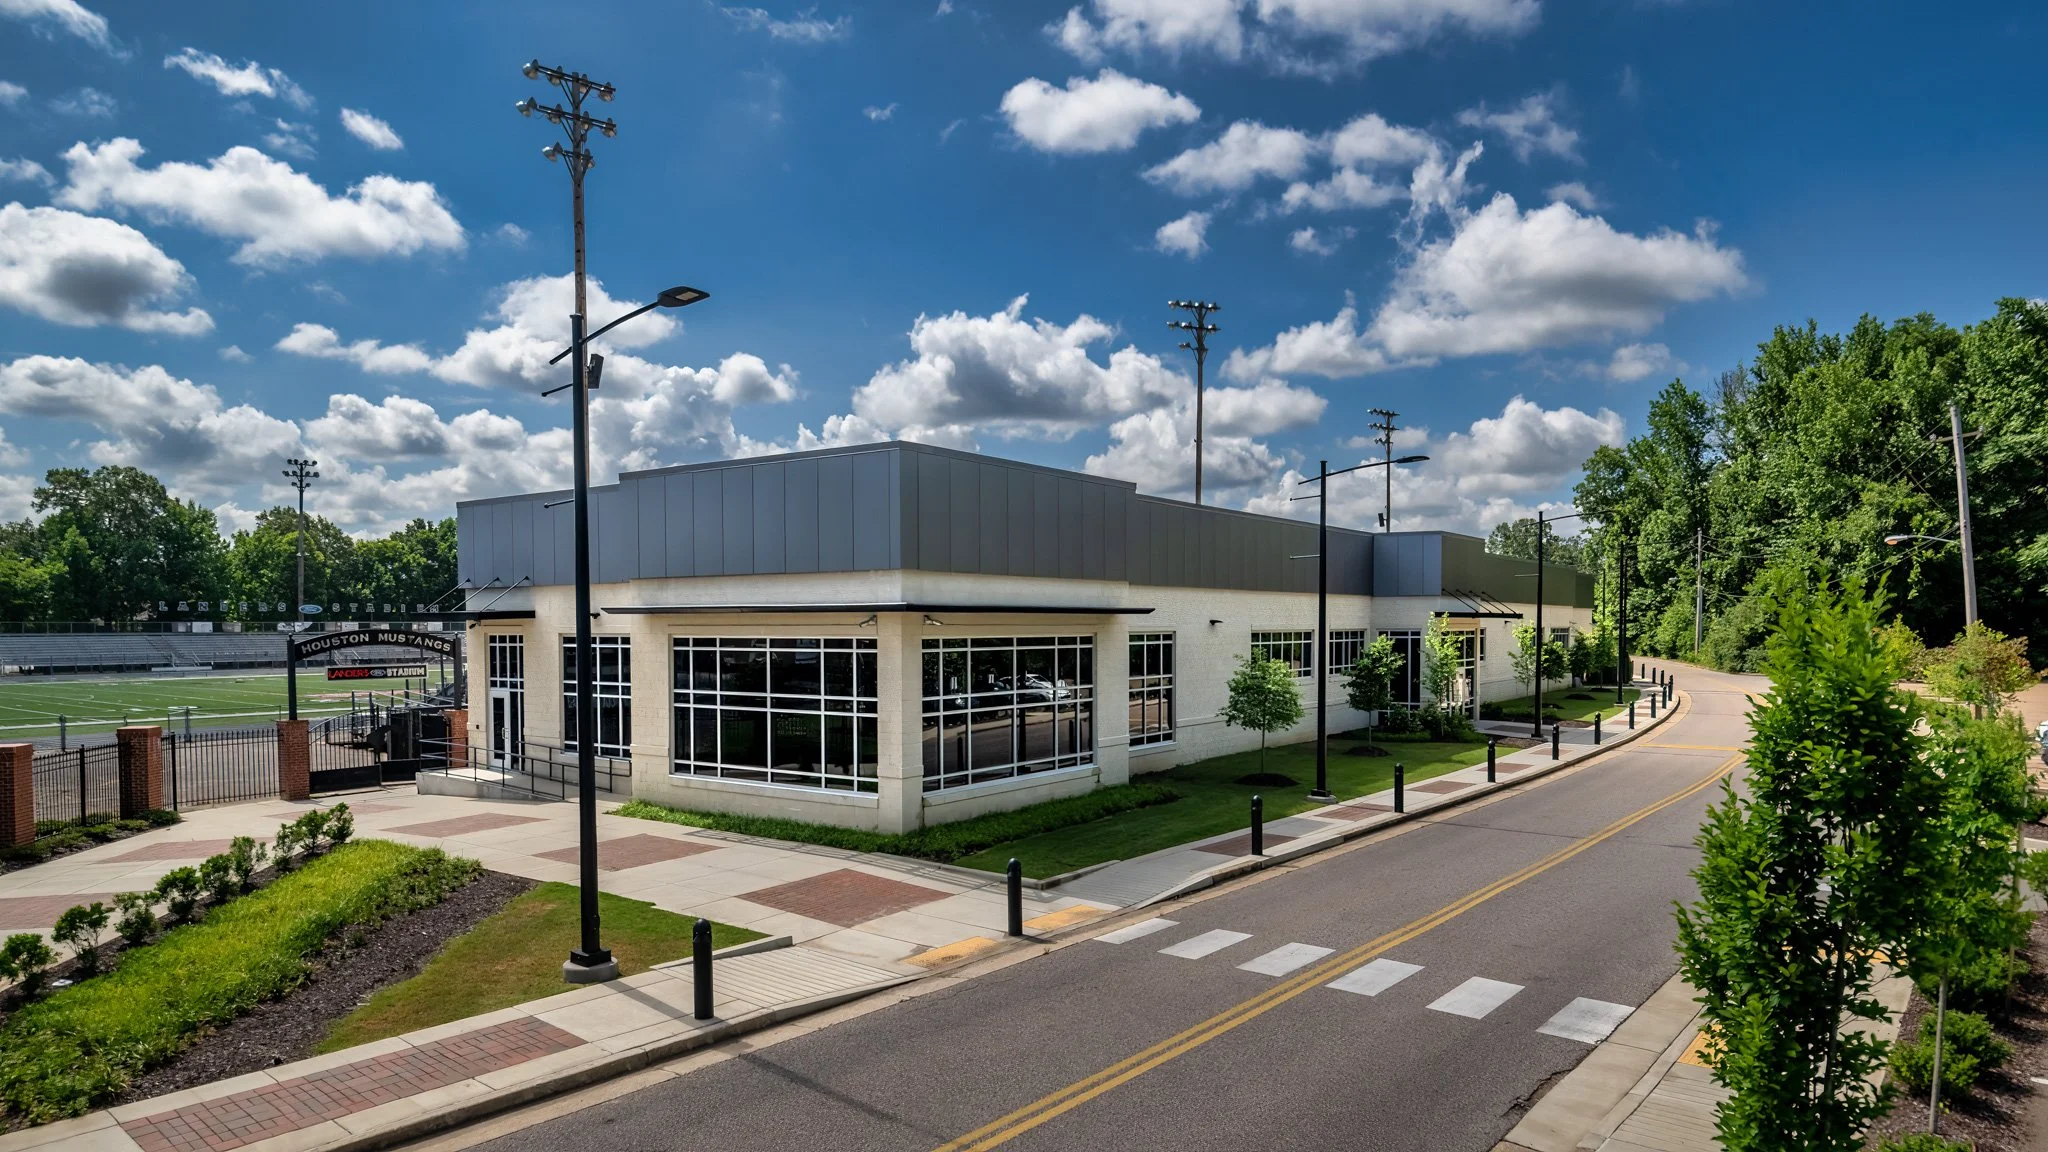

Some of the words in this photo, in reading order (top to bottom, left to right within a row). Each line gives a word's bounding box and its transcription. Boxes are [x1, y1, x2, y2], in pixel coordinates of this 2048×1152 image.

[159, 600, 287, 612] LANDERS
[331, 602, 440, 613] STADIUM
[301, 633, 370, 654] HOUSTON
[378, 632, 451, 652] MUSTANGS
[328, 668, 369, 678] LANDERS
[386, 667, 425, 677] STADIUM
